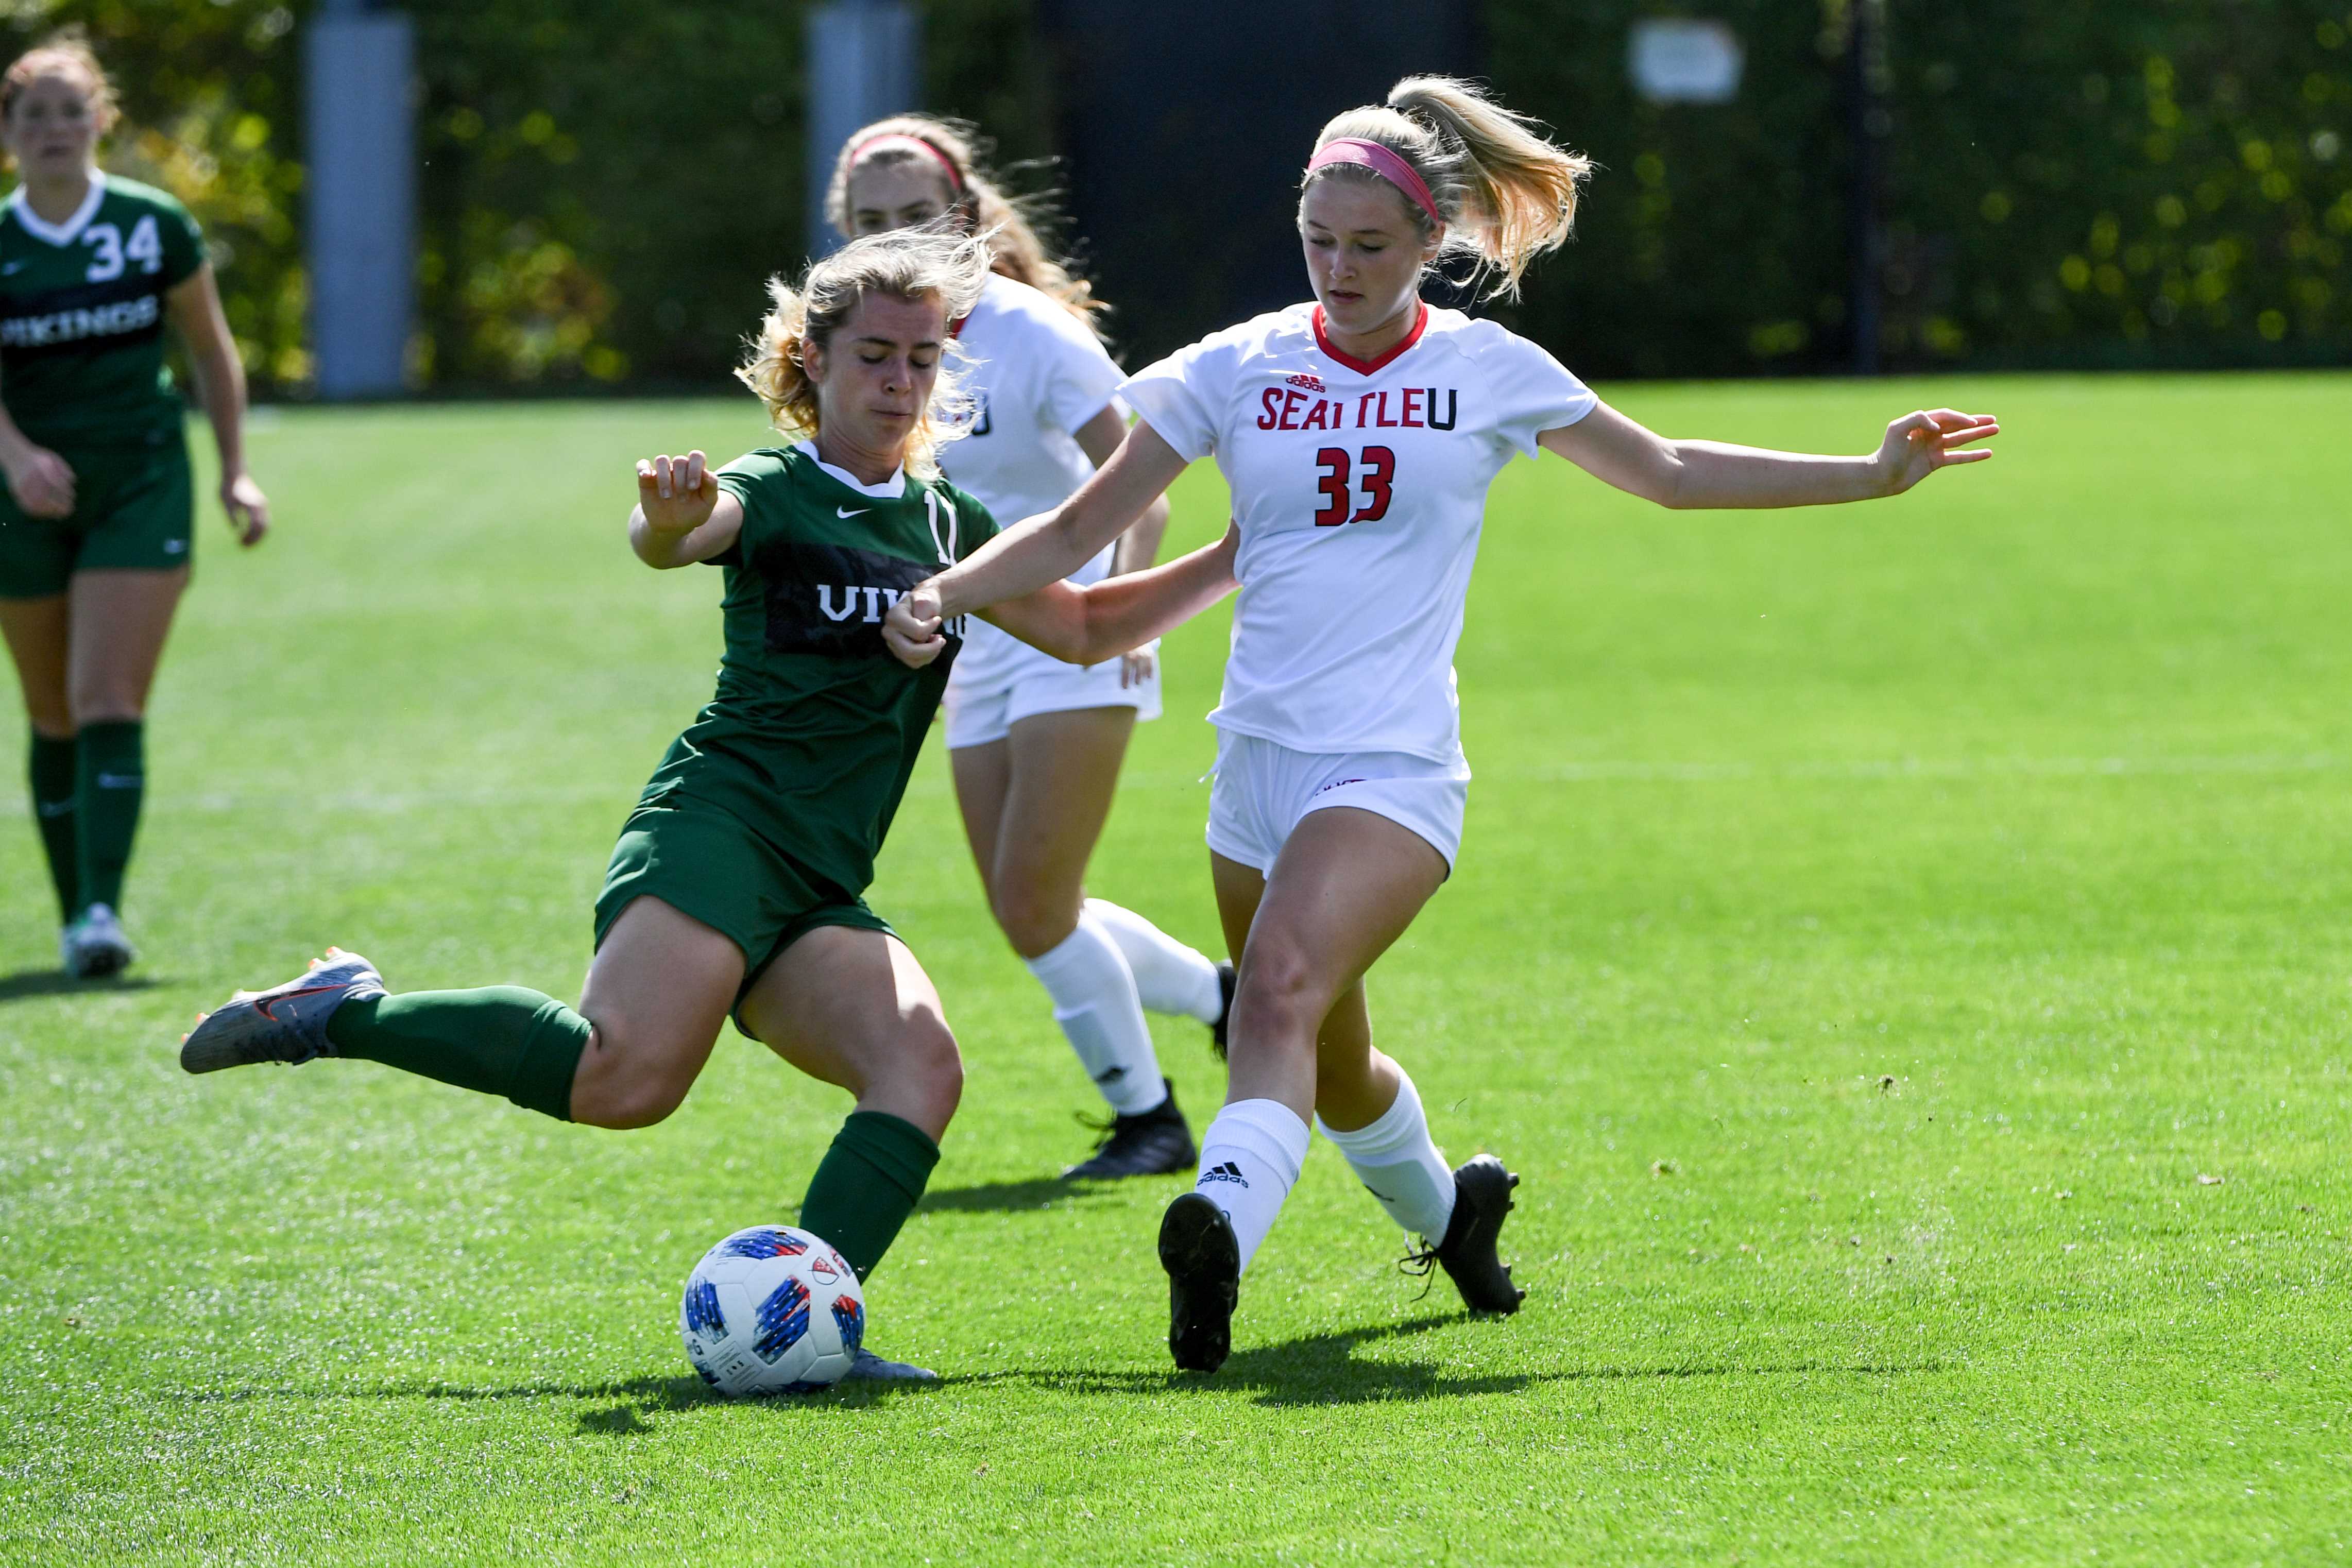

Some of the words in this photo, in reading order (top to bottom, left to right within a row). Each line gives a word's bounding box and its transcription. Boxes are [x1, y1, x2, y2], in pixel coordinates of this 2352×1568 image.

[81, 214, 161, 283] 34
[1315, 445, 1395, 526] 33
[1197, 1172, 1249, 1188] adidas
